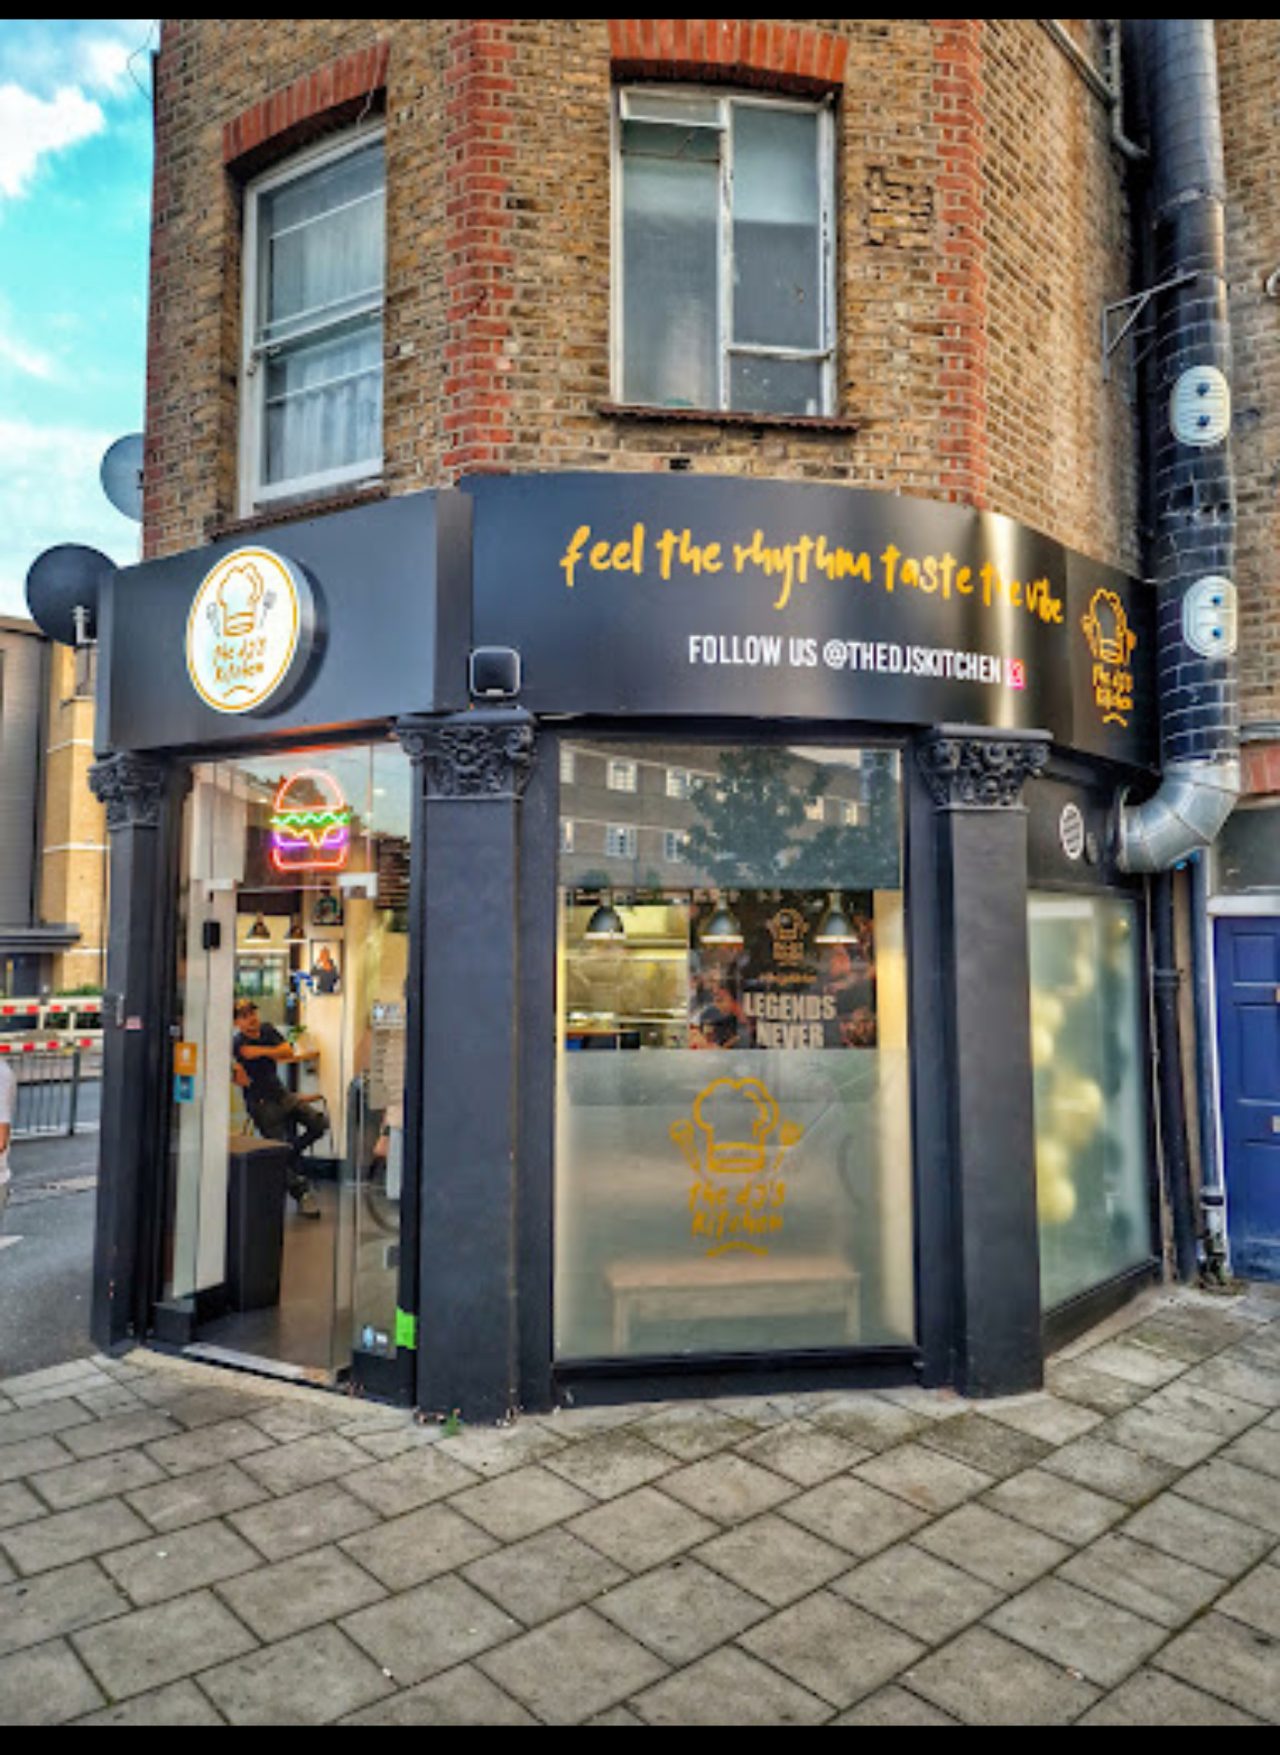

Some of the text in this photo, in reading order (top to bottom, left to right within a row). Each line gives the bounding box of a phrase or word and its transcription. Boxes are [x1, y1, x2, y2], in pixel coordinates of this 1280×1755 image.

[559, 522, 645, 587] feel
[656, 528, 723, 580] the
[733, 529, 872, 610] rhythm
[880, 544, 974, 599] taste
[688, 635, 1001, 684] FOLLOW US @THEDJSKITCHEN
[742, 992, 838, 1020] LEGENDS
[756, 1020, 825, 1049] NEVER
